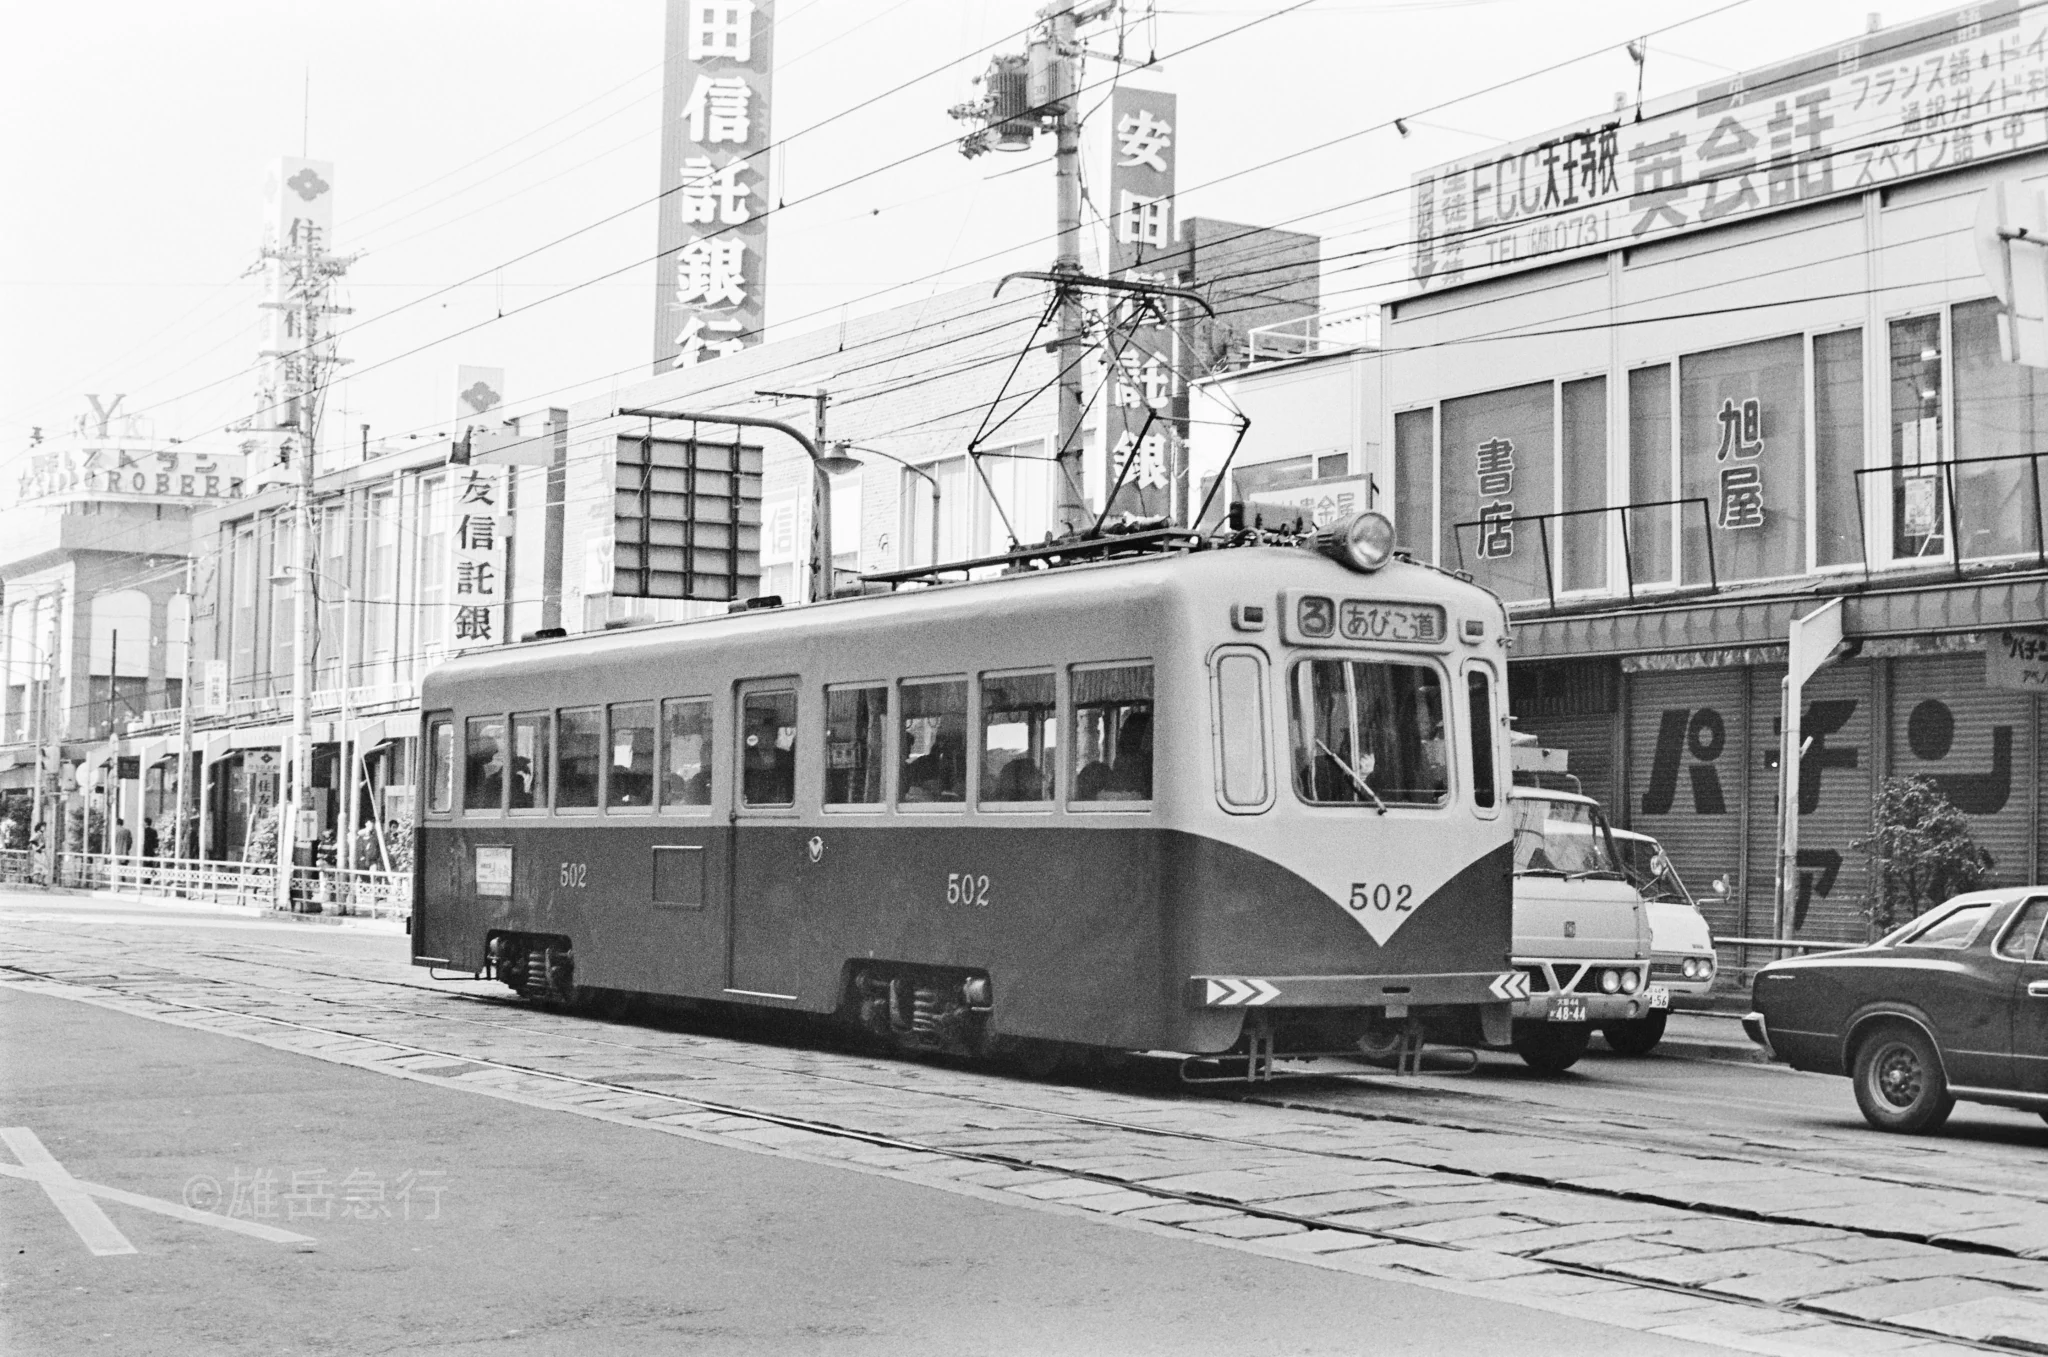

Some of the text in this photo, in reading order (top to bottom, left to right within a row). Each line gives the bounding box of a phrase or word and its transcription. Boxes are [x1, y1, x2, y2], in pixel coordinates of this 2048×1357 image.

[1628, 87, 1835, 239] 英会話
[1112, 110, 1173, 518] 安田信託銀
[1477, 437, 1514, 559] 書店
[1716, 398, 1764, 529] 旭屋
[1302, 601, 1439, 641] ろ あびこ道
[560, 862, 587, 888] 502
[947, 873, 990, 906] 502
[1349, 882, 1412, 912] 502
